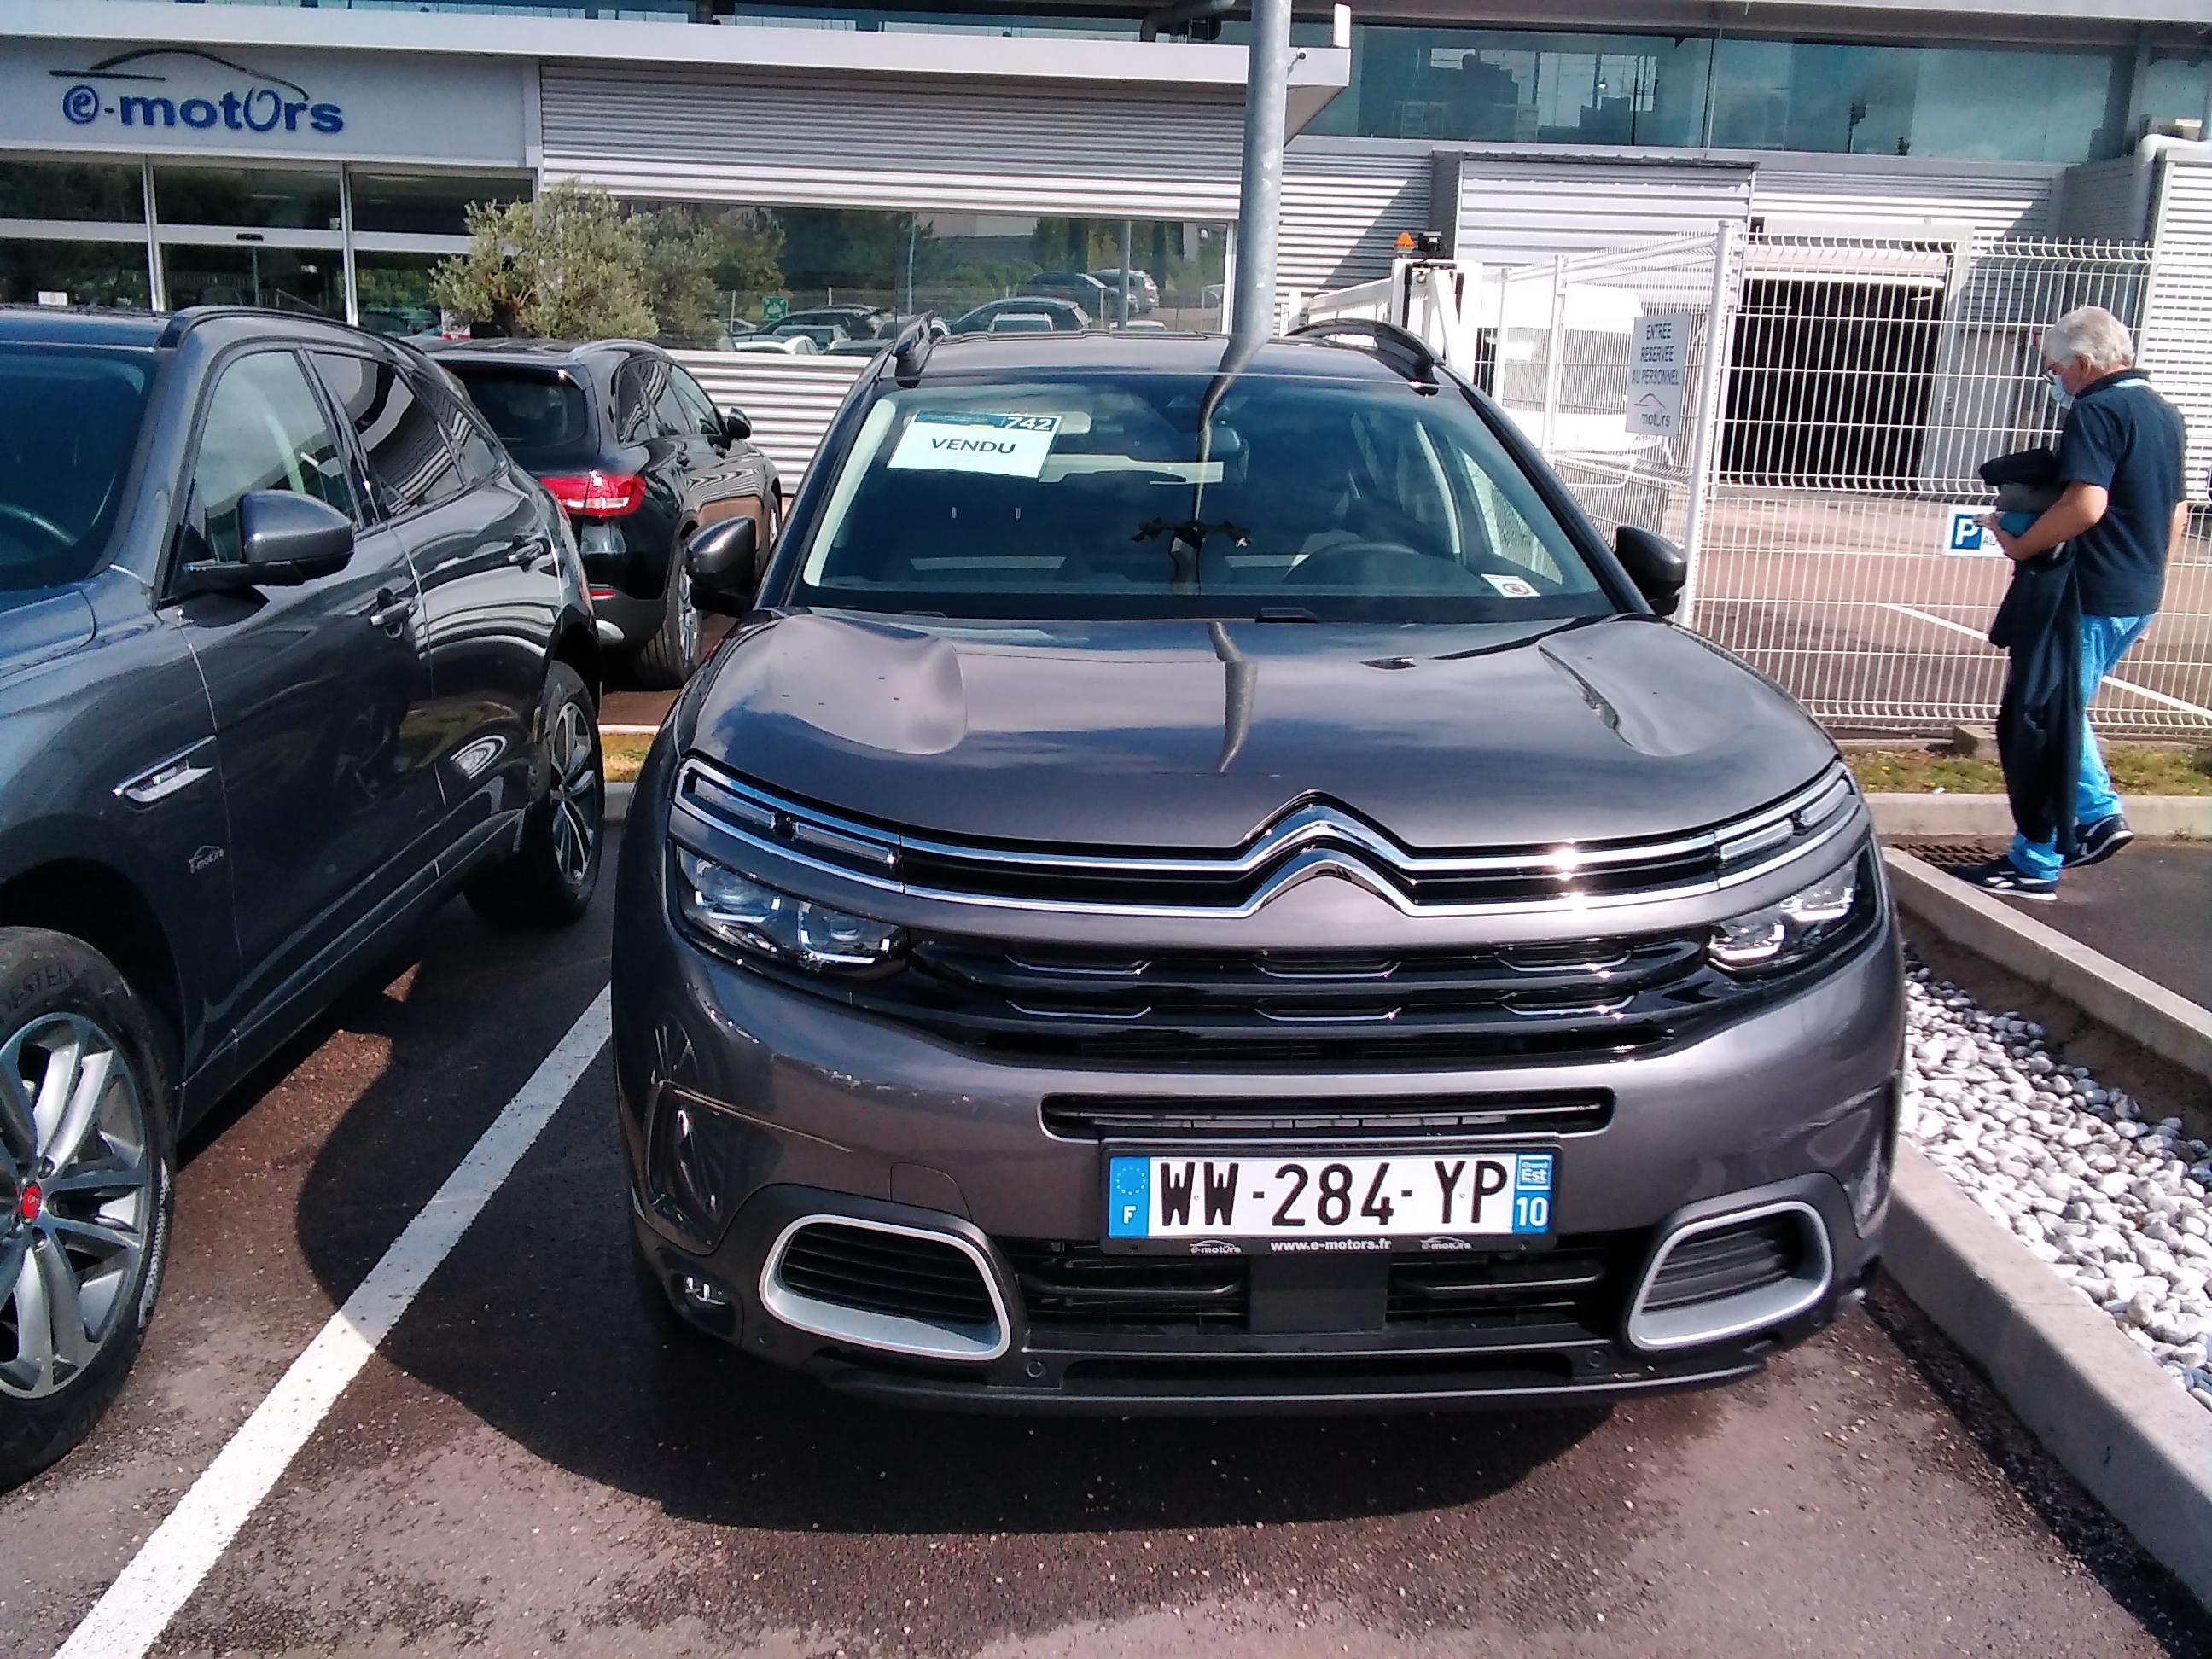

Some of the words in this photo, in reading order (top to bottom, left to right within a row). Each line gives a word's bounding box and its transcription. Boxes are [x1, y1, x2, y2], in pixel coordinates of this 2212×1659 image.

[1646, 320, 1672, 340] ENTRÉE
[1631, 369, 1640, 384] AU
[1641, 369, 1679, 385] PERSONNEL
[1004, 416, 1052, 431] 742
[931, 438, 1016, 454] VENDU
[1522, 1169, 1547, 1181] Est
[1123, 1205, 1137, 1225] F
[1516, 1196, 1549, 1226] 10
[1270, 1237, 1392, 1252] www.e-motors.fr
